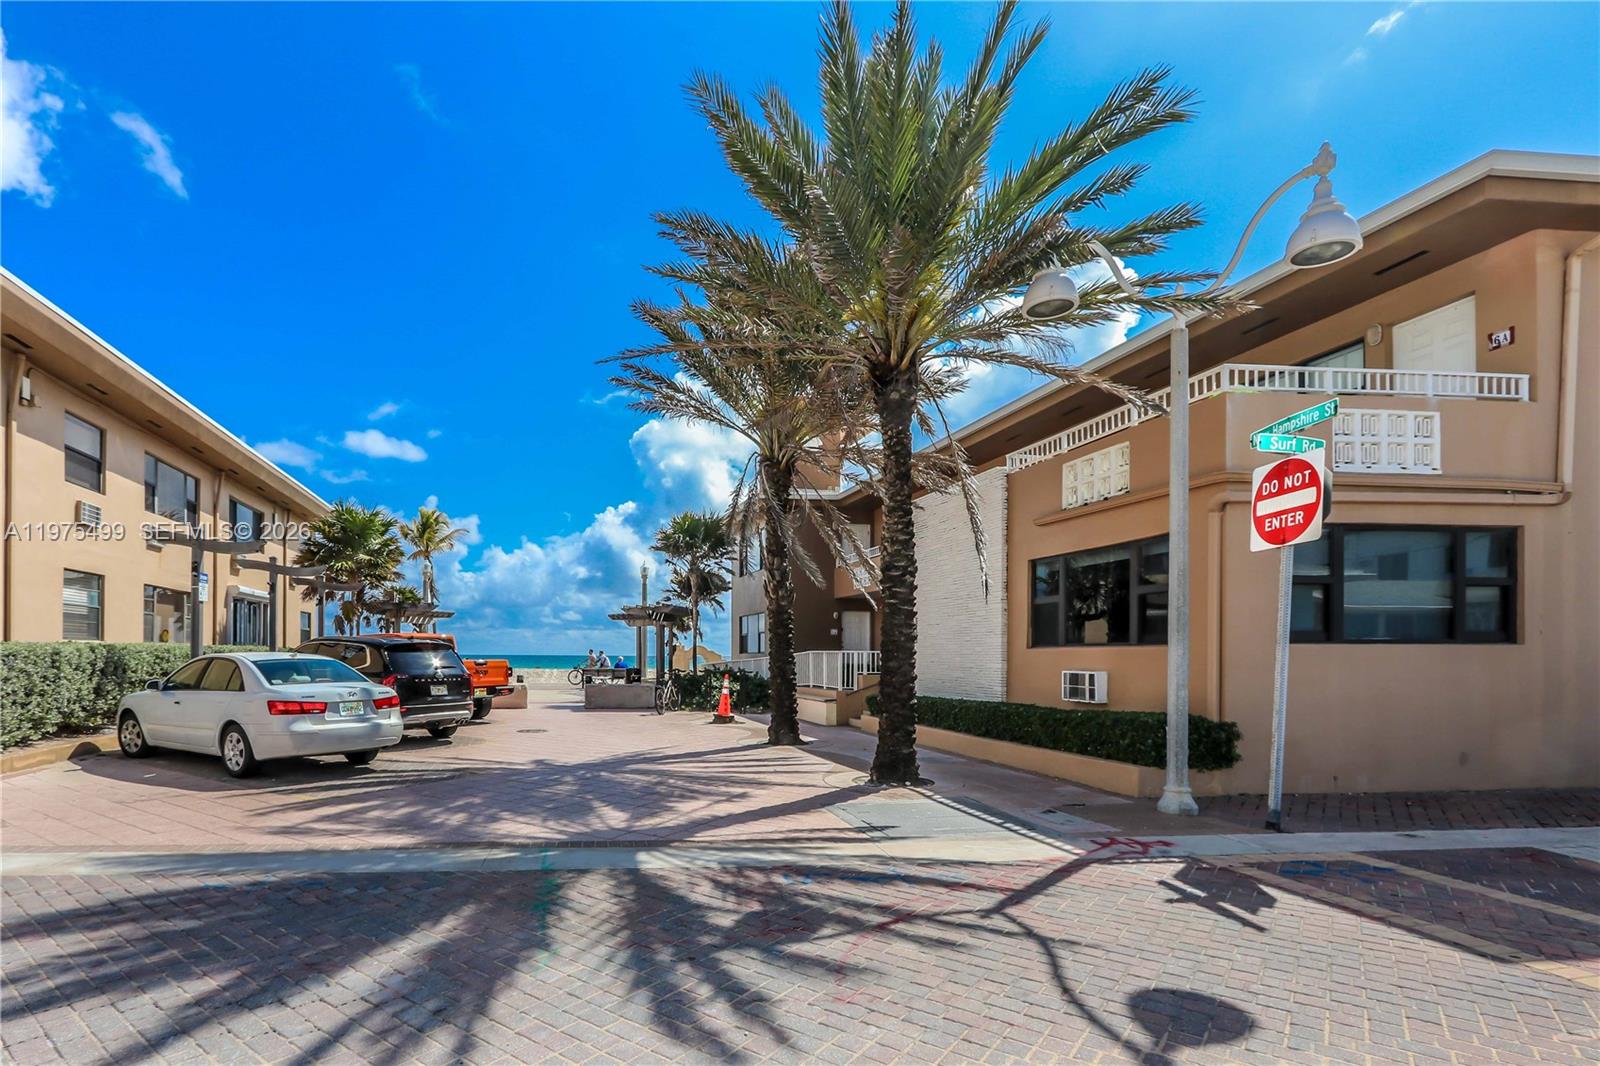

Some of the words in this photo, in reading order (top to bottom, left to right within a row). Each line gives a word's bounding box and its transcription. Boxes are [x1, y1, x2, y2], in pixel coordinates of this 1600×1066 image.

[1494, 333, 1508, 345] 6A
[1272, 411, 1320, 434] Hampshire
[1324, 402, 1335, 417] St
[1270, 437, 1297, 451] Surf
[1302, 440, 1316, 453] Rd
[1262, 480, 1279, 496] DO
[1284, 470, 1312, 489] NOT
[1264, 511, 1304, 532] ENTER
